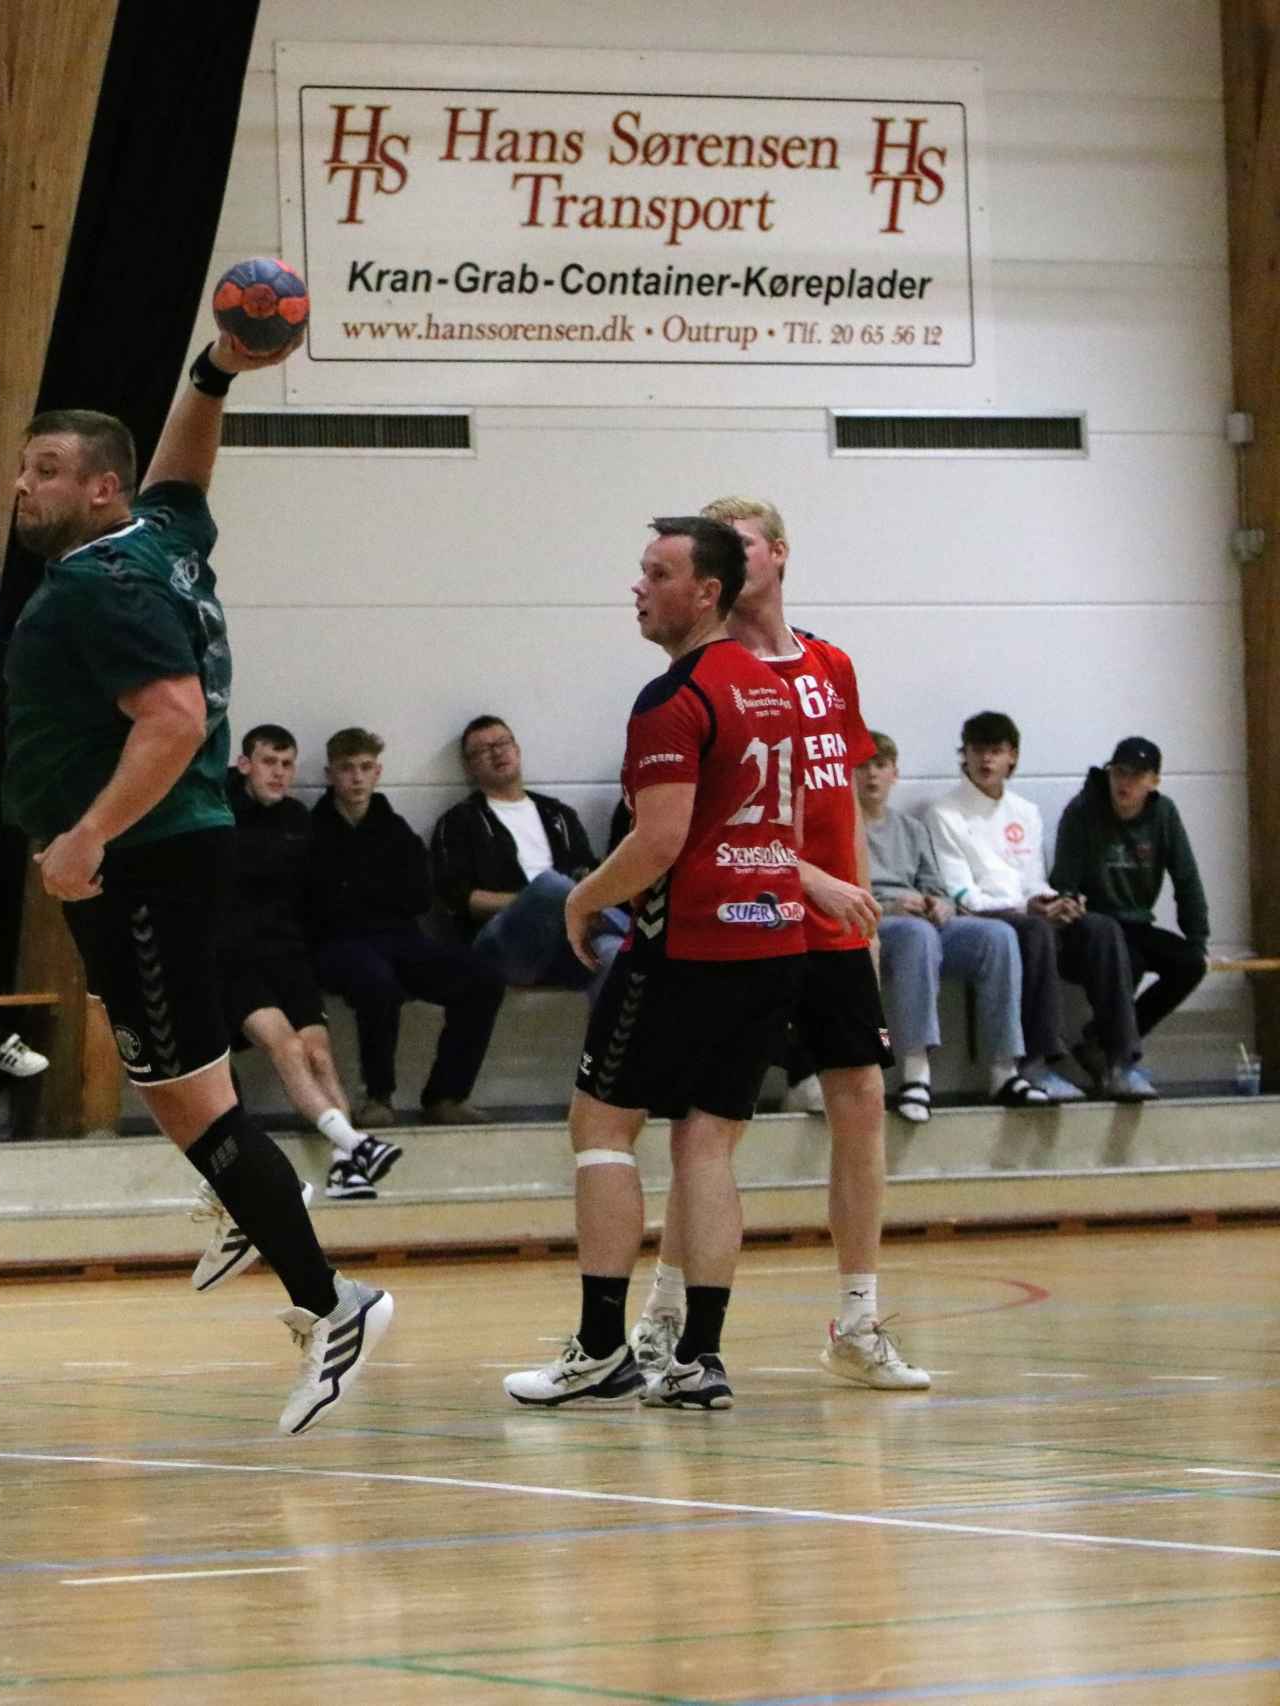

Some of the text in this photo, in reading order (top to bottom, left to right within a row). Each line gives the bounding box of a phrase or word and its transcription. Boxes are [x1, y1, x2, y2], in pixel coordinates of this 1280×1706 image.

[439, 107, 839, 170] Hans Sørensen
[511, 173, 775, 246] Transport
[342, 314, 942, 350] www.hanssorensen.dk Outrup Tlf. 20 65 56 12
[724, 736, 794, 825] 21
[726, 904, 770, 920] SUPER
